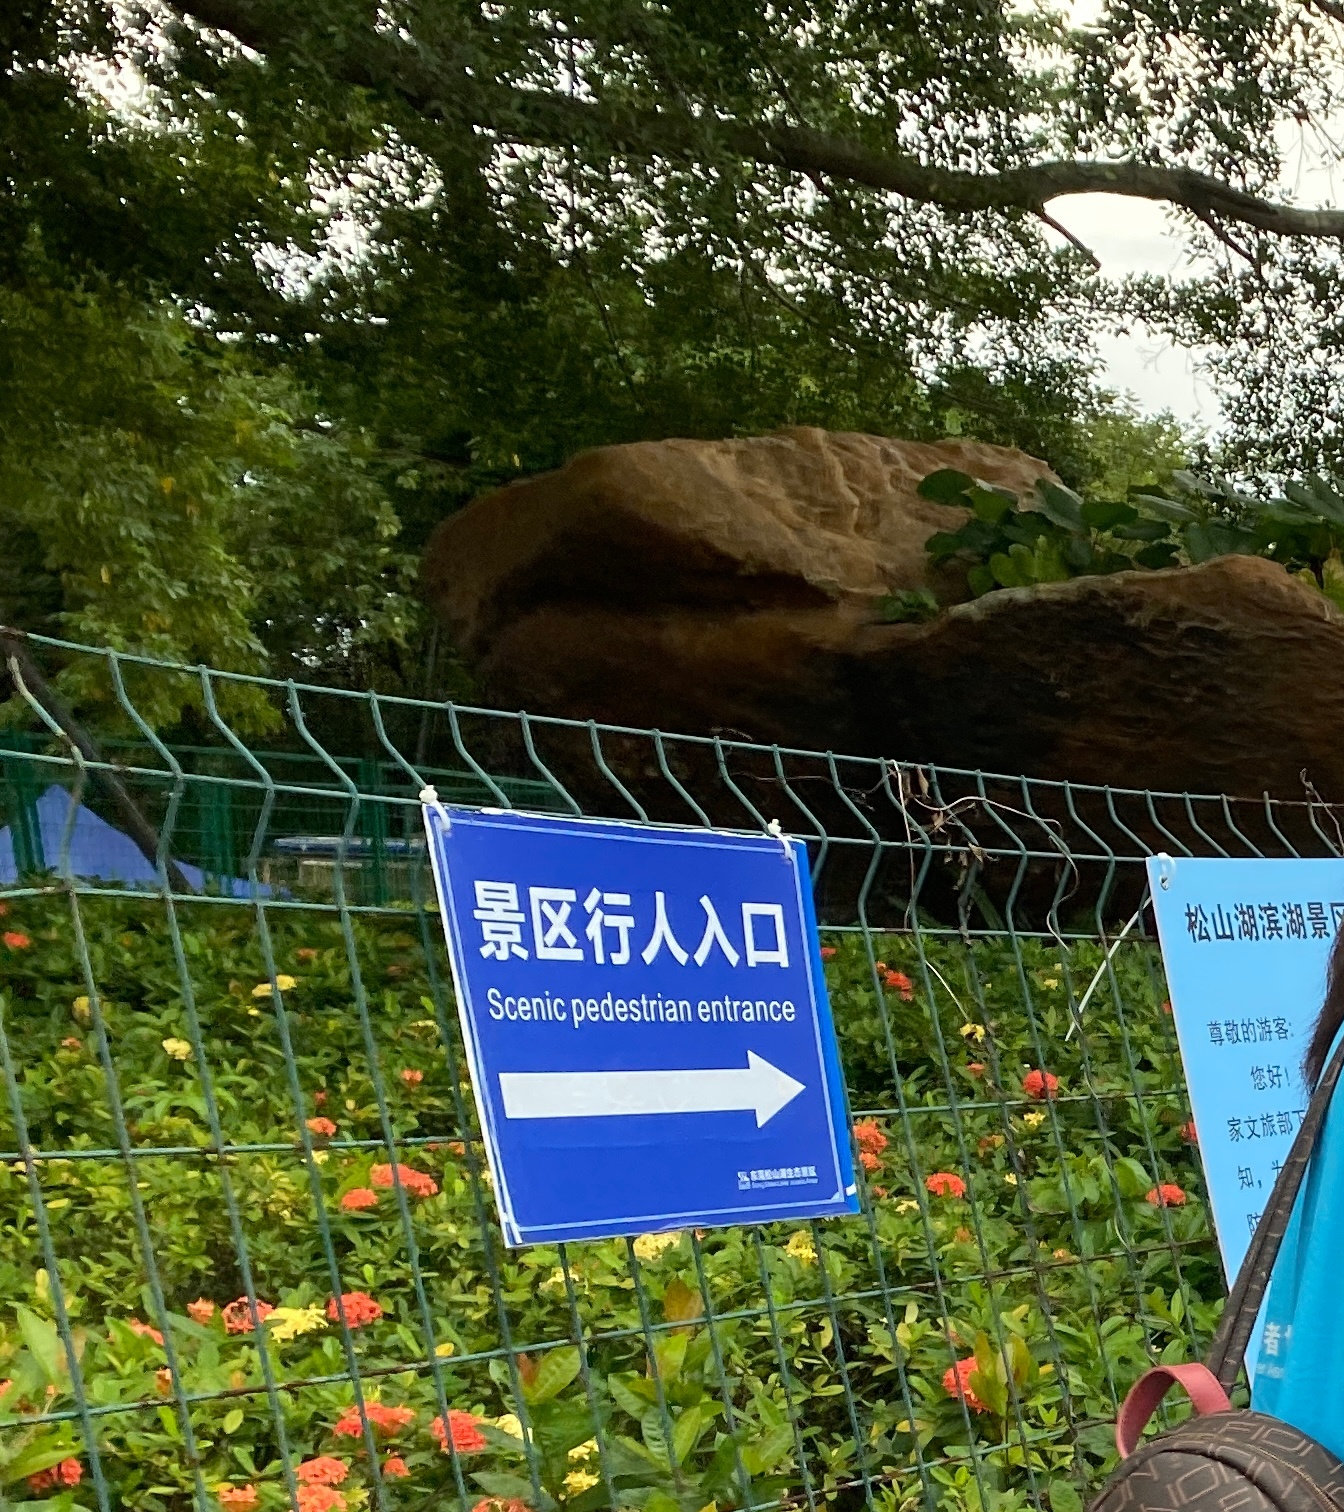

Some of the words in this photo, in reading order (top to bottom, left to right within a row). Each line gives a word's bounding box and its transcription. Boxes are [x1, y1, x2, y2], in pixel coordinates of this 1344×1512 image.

[473, 880, 790, 968] 景区行人入口
[487, 987, 567, 1022] Scenic
[571, 991, 693, 1029] pedestrian
[697, 994, 796, 1023] entrance
